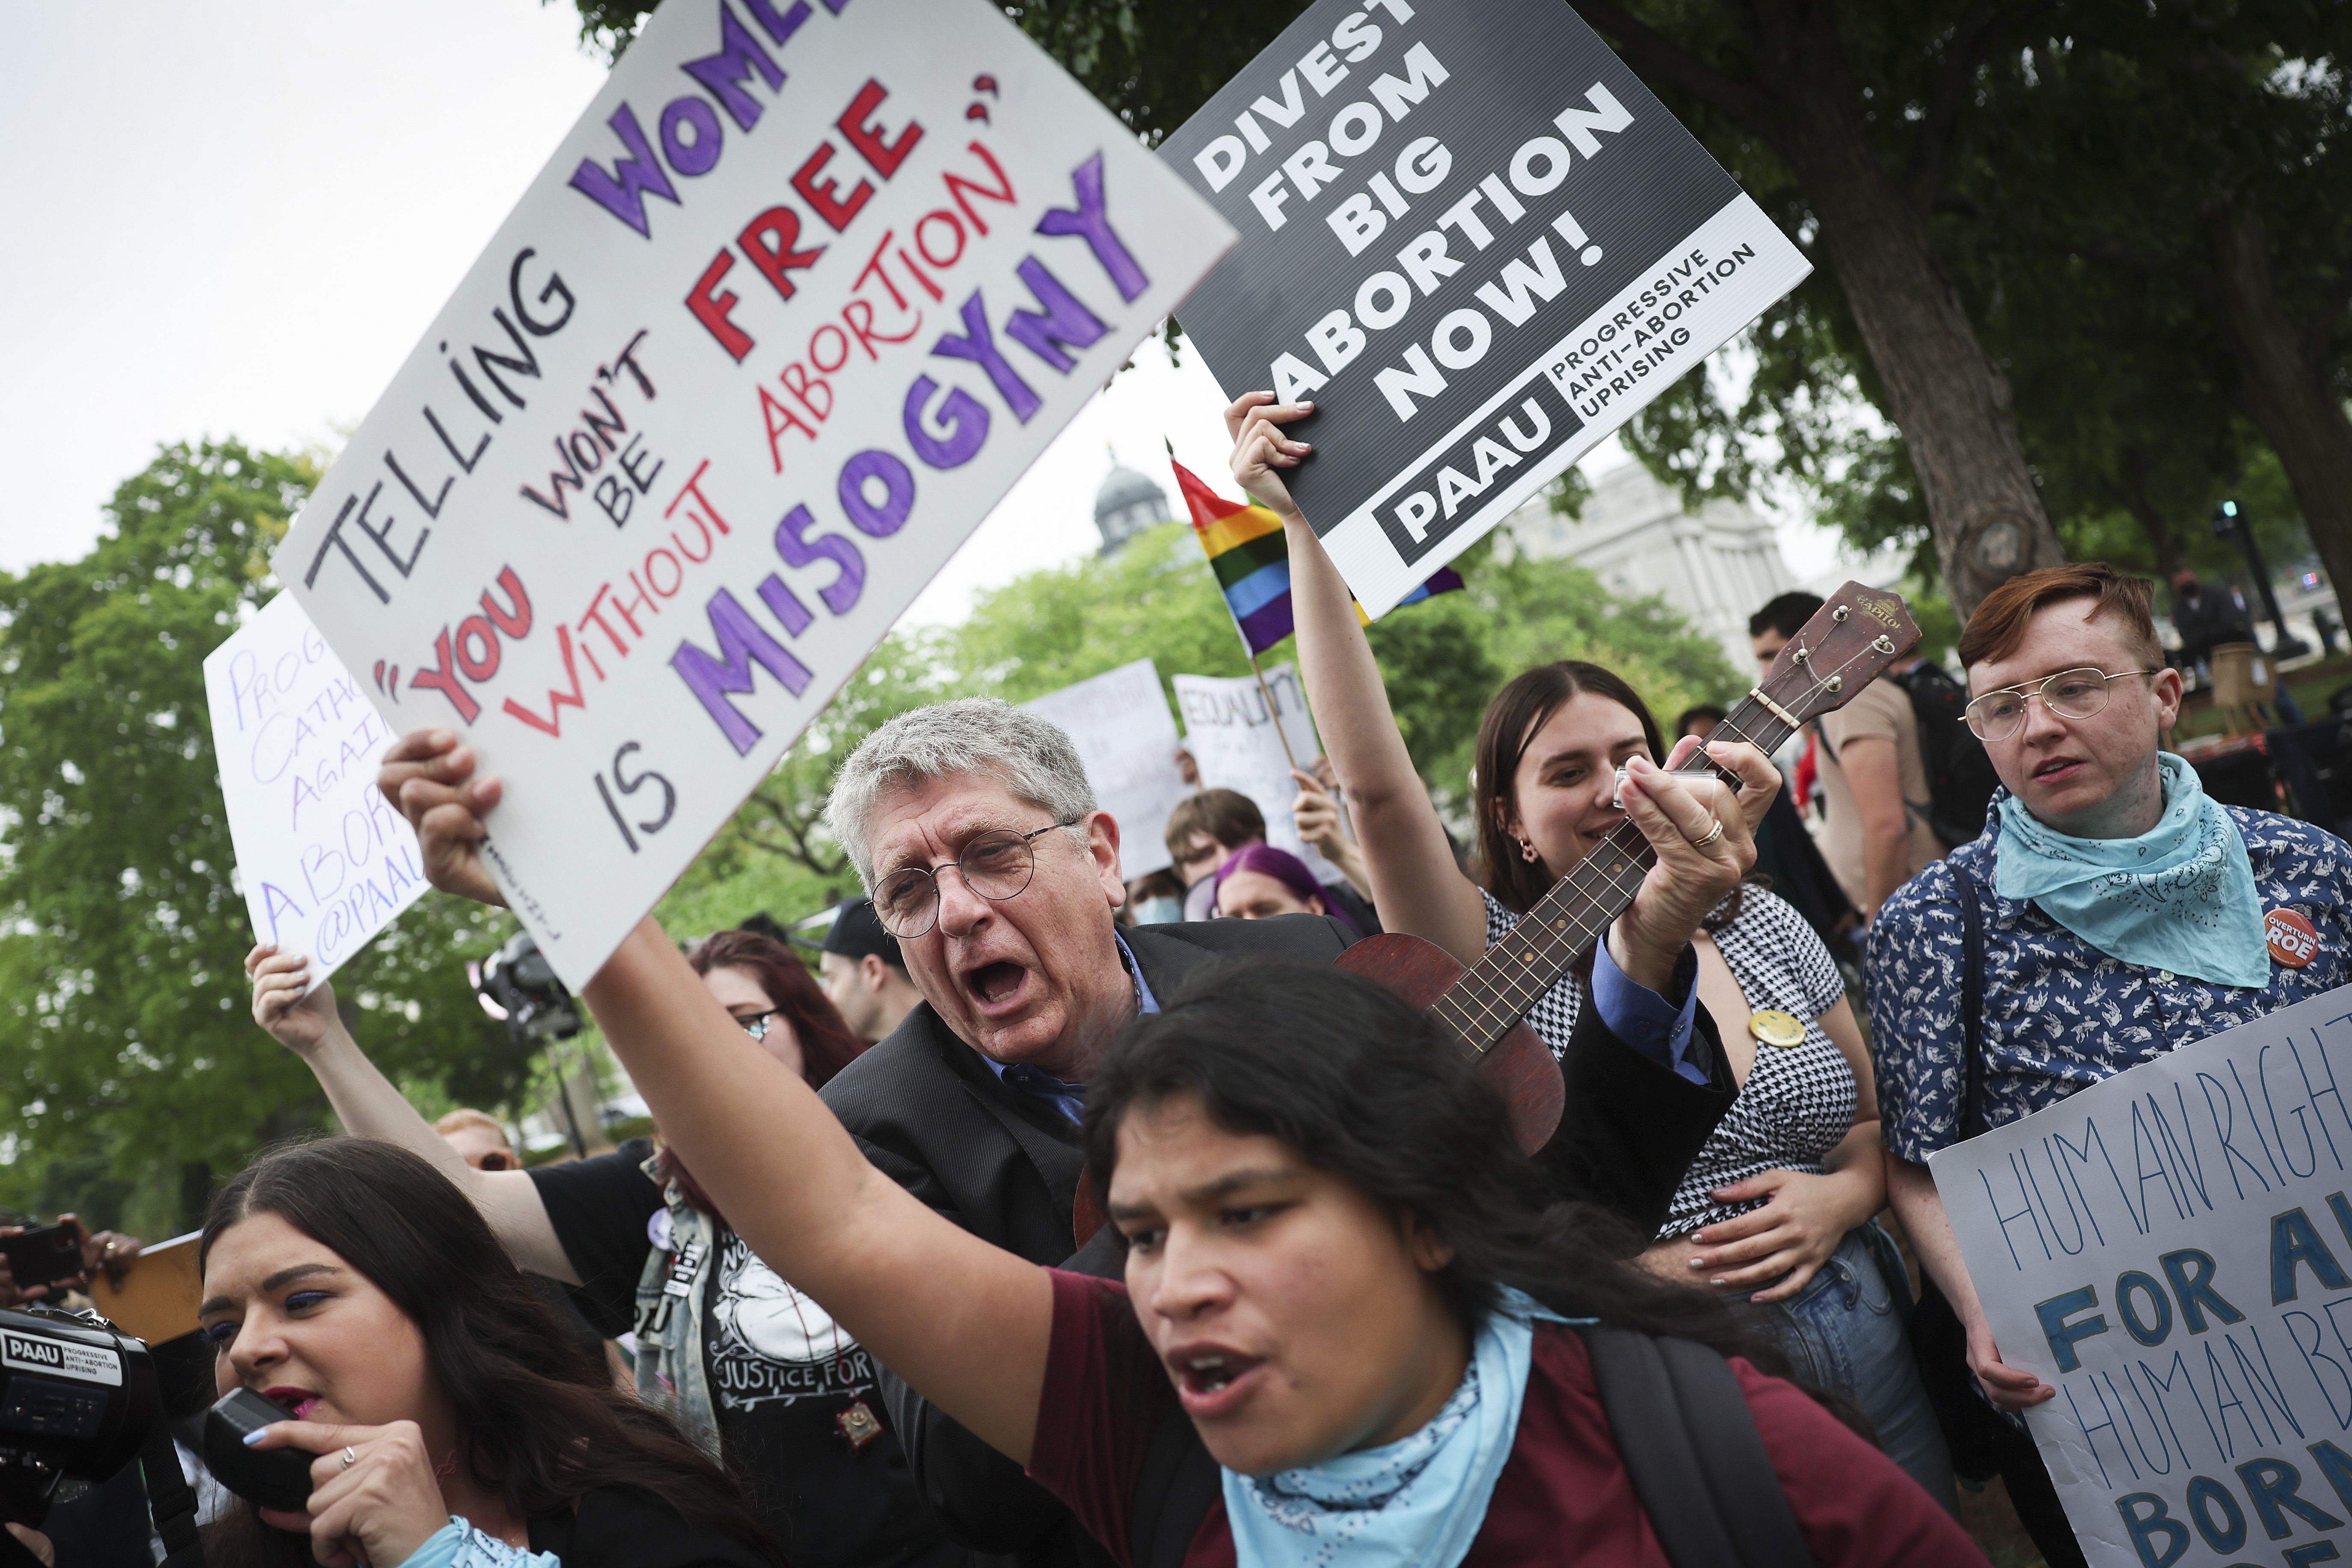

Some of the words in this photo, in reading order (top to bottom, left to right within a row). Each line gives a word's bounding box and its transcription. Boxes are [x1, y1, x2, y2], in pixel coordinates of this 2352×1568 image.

[1193, 0, 1416, 193] DIVEST
[1248, 40, 1450, 232] FROM
[684, 76, 925, 365] FREE
[1270, 81, 1635, 406] ABORTION
[1325, 136, 1453, 257] BIG
[304, 247, 576, 604] TELLING
[568, 0, 852, 240] WOME
[1373, 210, 1603, 422] NOW!
[1551, 249, 1708, 380] PROGRESSIVE
[1566, 243, 1756, 399] ANTI-ABORTION
[1581, 326, 1691, 418] UPRISING
[519, 328, 656, 523] WON'T
[593, 432, 665, 529] BE
[1394, 397, 1552, 544] PAAU
[594, 741, 676, 854] IS
[669, 147, 1152, 757] MISOGYNY
[503, 459, 731, 738] WITHOUT
[229, 625, 325, 732] PROG
[261, 781, 395, 943] ABOR
[2268, 916, 2316, 947] OVERTURN
[2266, 925, 2313, 961] ROE
[1978, 1082, 2213, 1271] HUMAN
[2195, 1013, 2352, 1200] RIGH
[9, 1338, 59, 1364] PAAU
[64, 1347, 108, 1360] PROGRESSIVE
[65, 1355, 118, 1370] ANTI-ABORTION
[65, 1365, 97, 1375] UPRISING
[718, 1360, 816, 1390] JUSTICE
[823, 1351, 872, 1387] FOR
[2034, 1248, 2246, 1373] FOR
[2063, 1325, 2305, 1489] HUMAN
